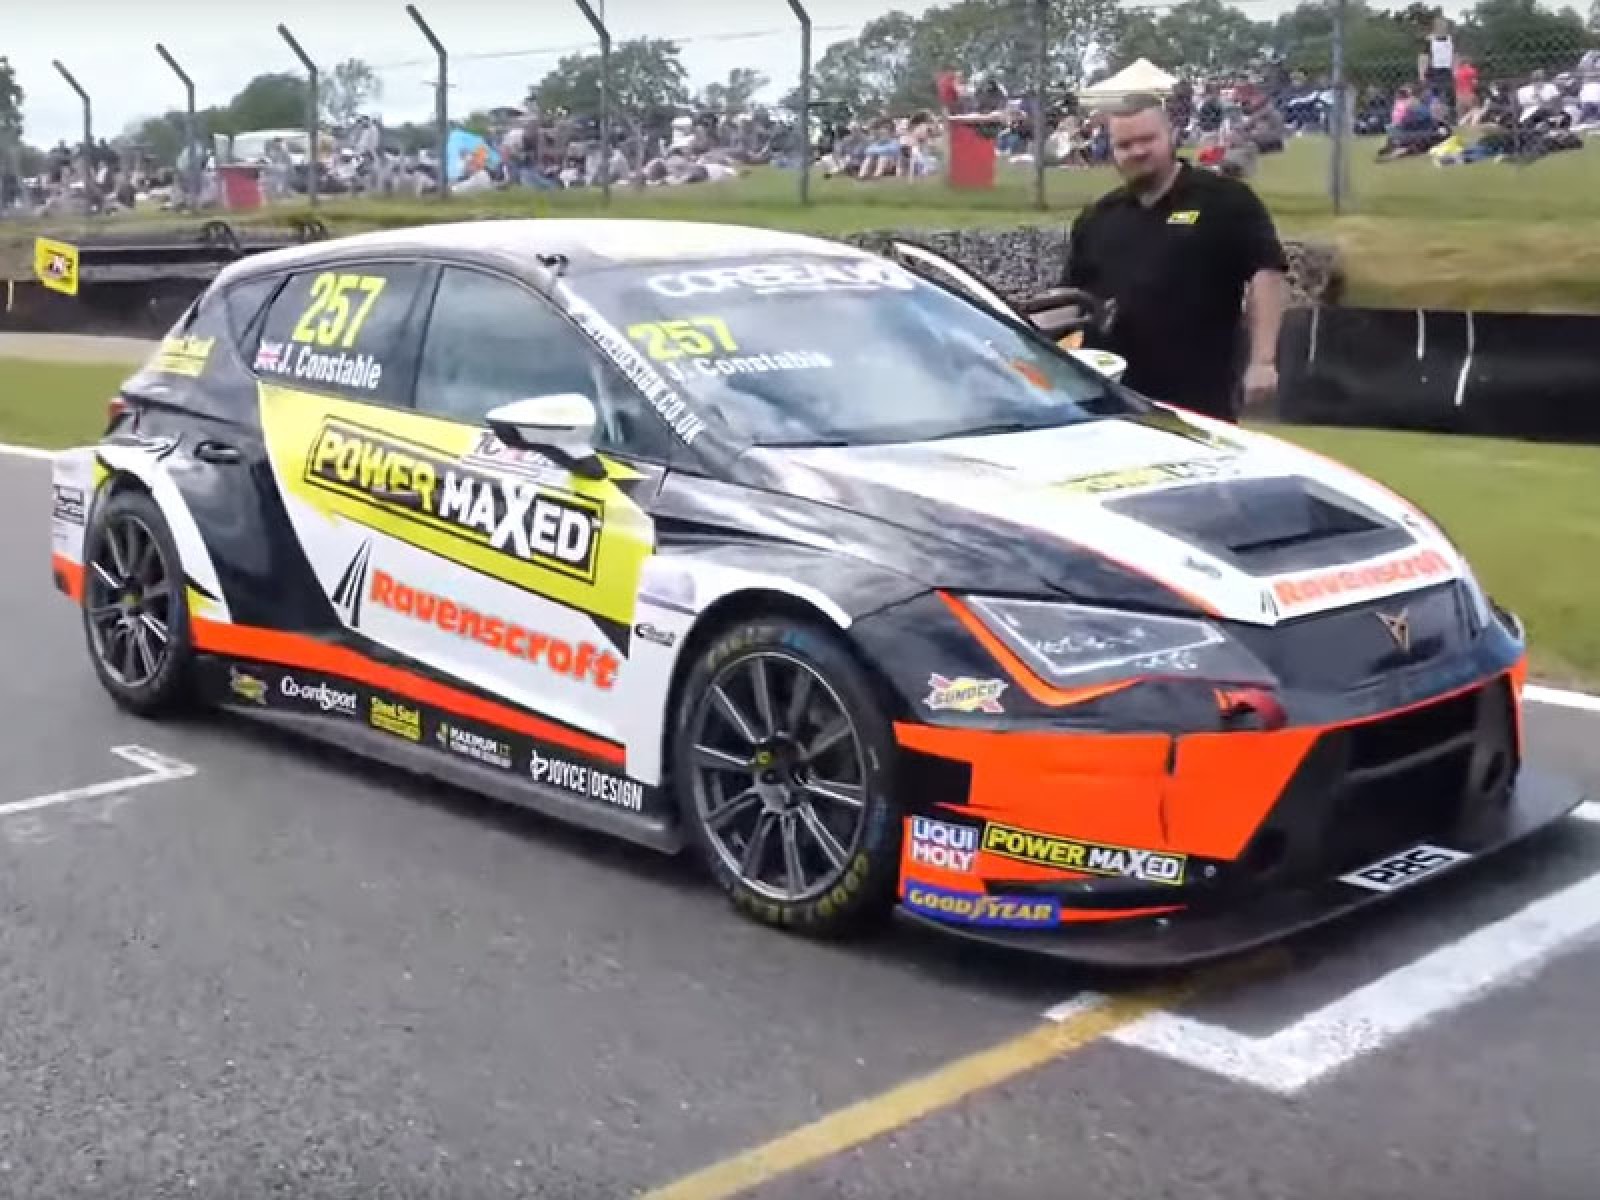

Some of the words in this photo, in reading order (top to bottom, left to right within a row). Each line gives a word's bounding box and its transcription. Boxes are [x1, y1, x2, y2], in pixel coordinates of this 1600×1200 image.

[291, 271, 387, 348] 257
[627, 315, 739, 361] 257
[295, 345, 383, 389] Constable
[314, 429, 436, 511] POWER
[438, 470, 593, 563] MAXED
[369, 567, 623, 692] Ravenscroft
[933, 682, 1000, 706] SUNOCO
[911, 840, 975, 872] MOLY
[912, 817, 979, 850] LIQUI
[987, 826, 1087, 866] POWER
[1087, 847, 1180, 880] MAXED
[908, 888, 1054, 922] GOODYEAR
